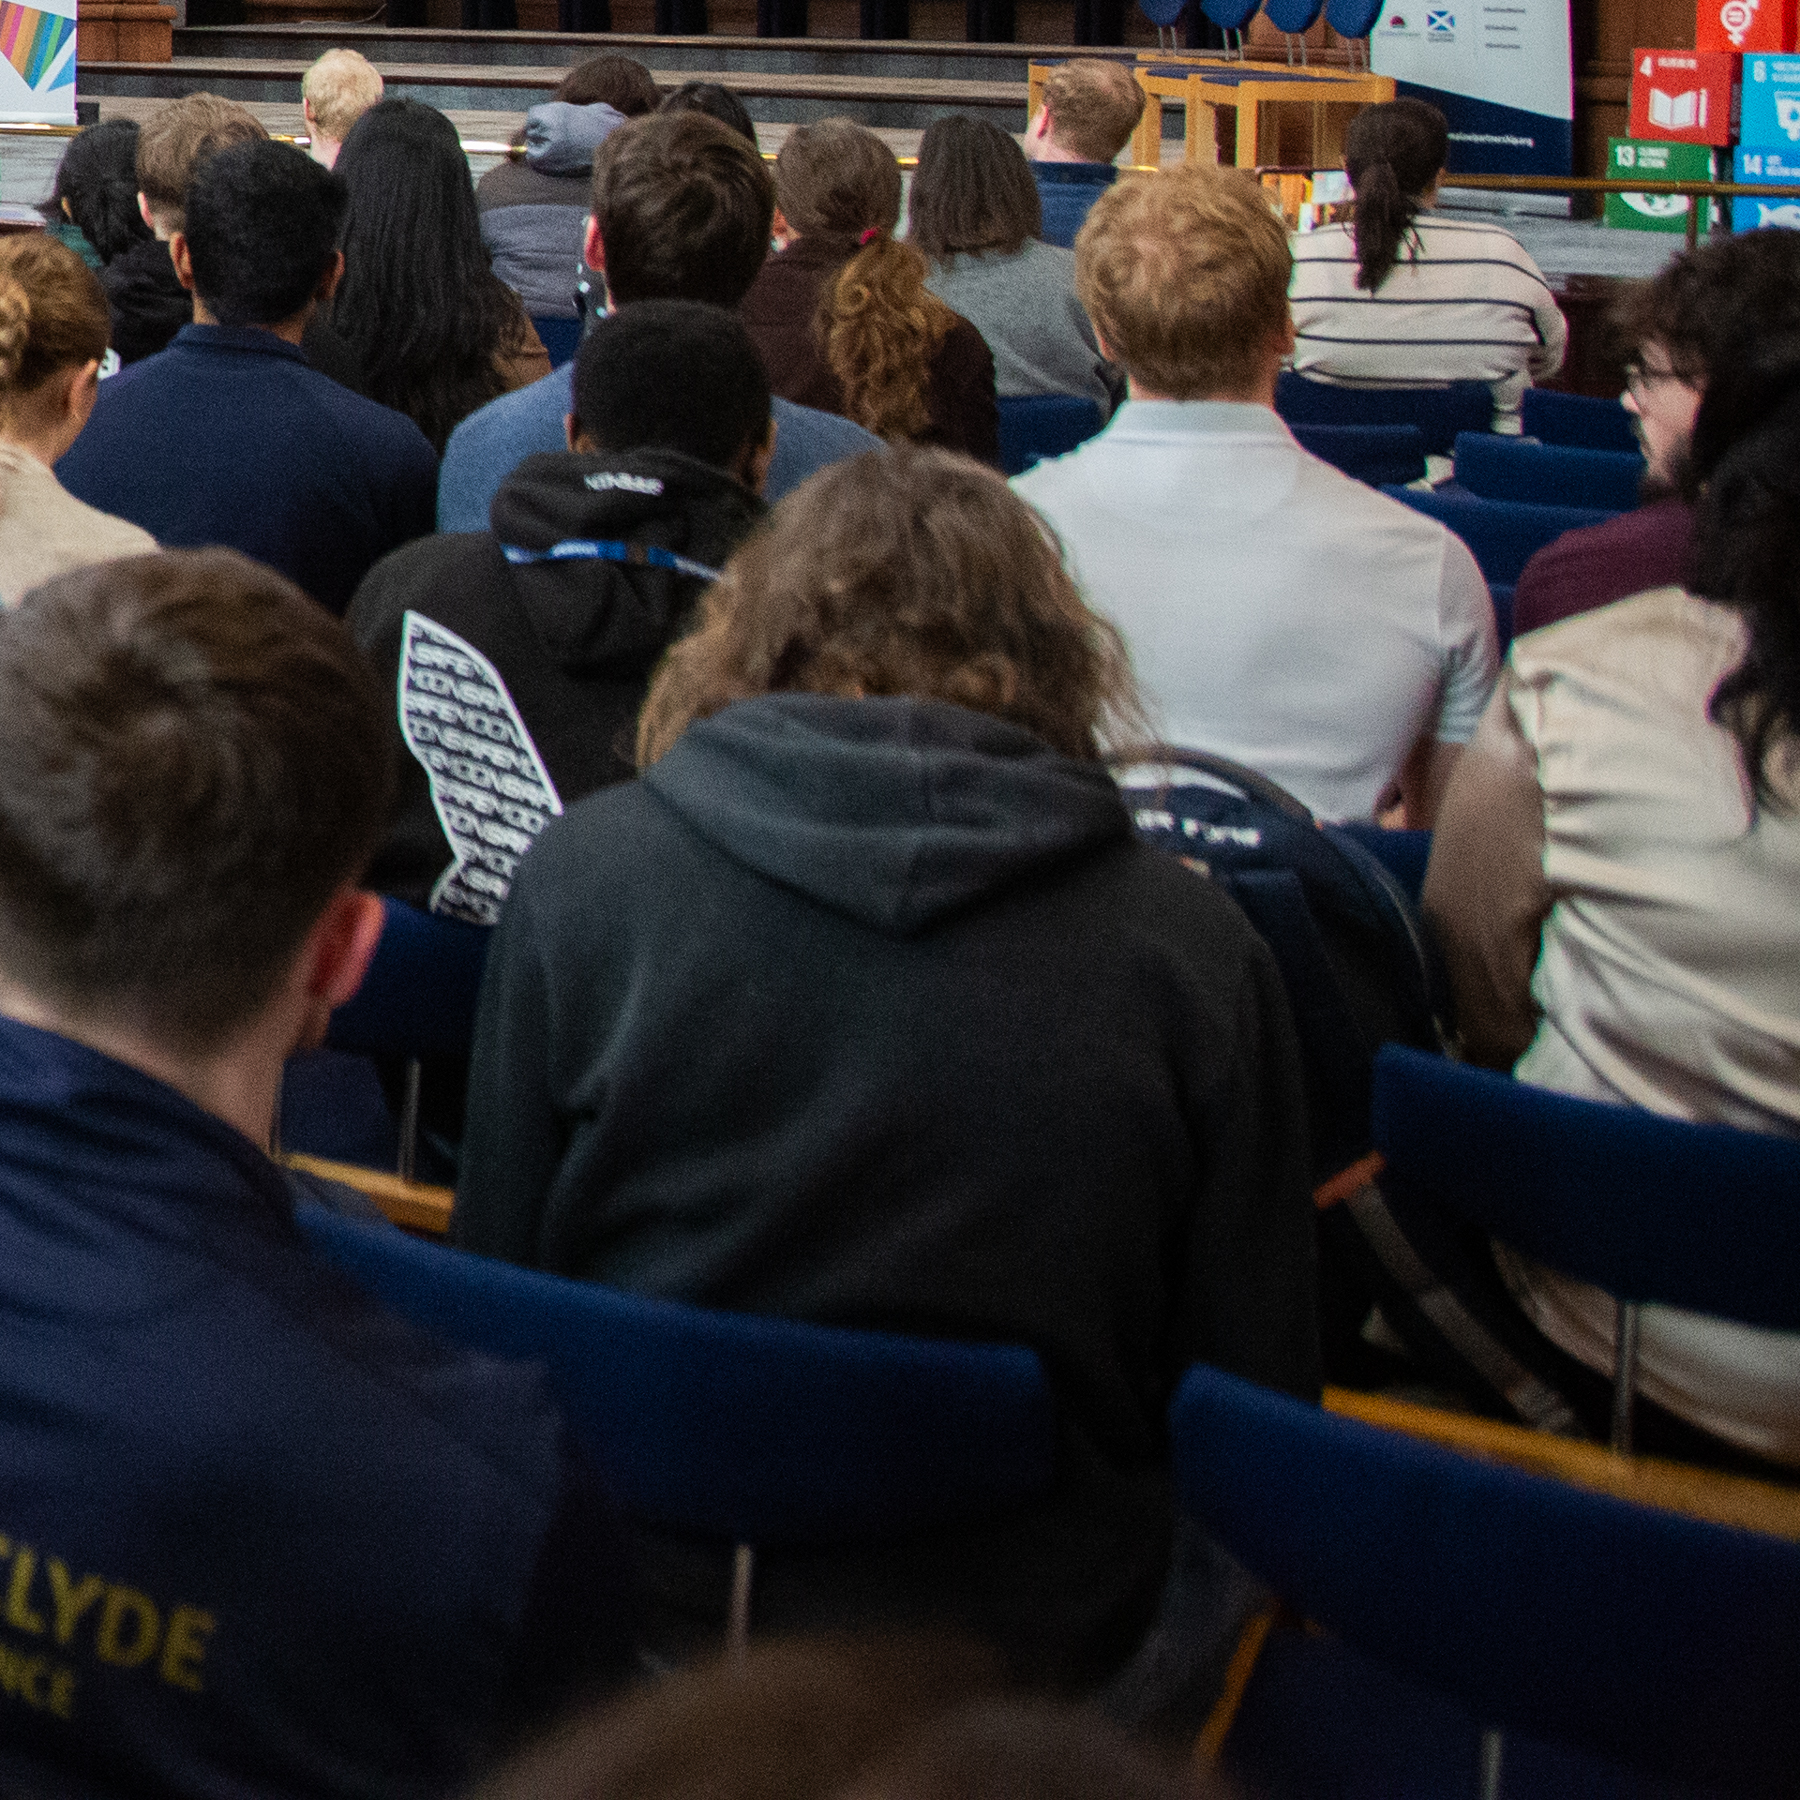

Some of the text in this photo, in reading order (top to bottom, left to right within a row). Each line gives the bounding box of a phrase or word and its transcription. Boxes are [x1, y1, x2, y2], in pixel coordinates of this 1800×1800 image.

[1639, 56, 1652, 77] 4
[1615, 145, 1636, 168] 13
[1743, 153, 1763, 176] 14
